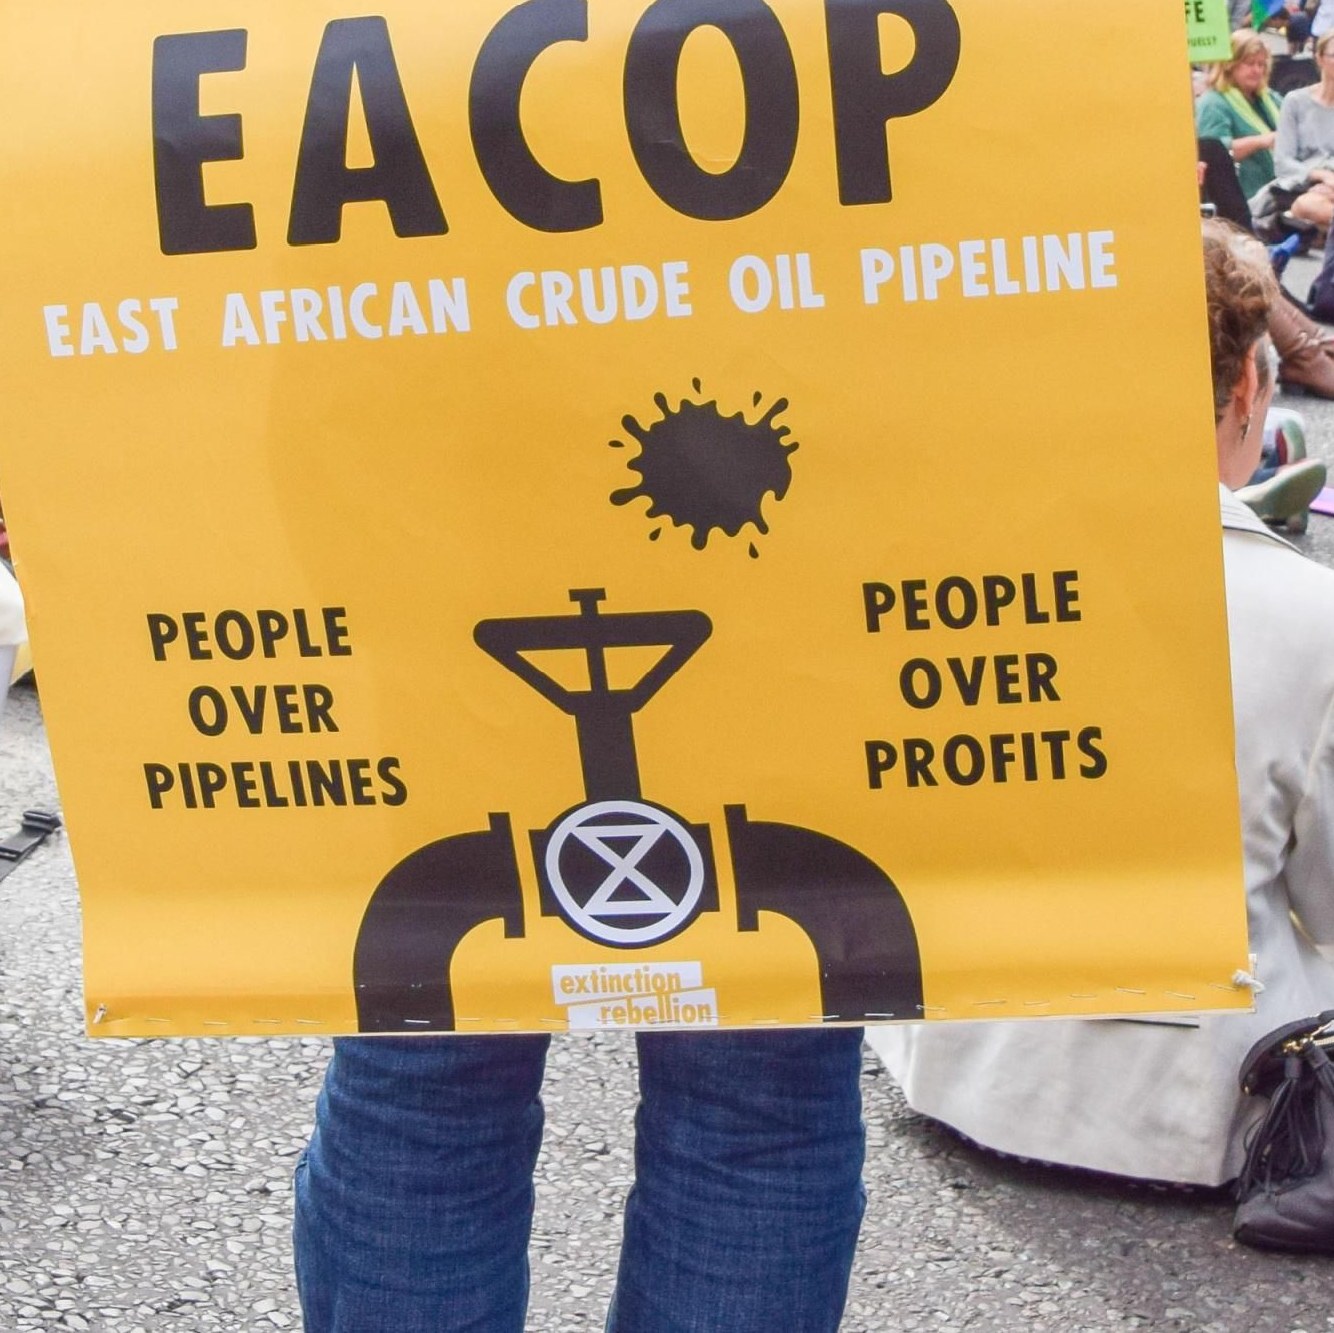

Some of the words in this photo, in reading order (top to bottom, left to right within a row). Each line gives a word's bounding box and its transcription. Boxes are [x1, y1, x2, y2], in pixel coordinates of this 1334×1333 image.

[43, 298, 179, 357] EAST
[222, 278, 471, 347] AFRICAN
[507, 262, 692, 328] CRUDE
[730, 254, 825, 313] OIL
[861, 231, 1118, 304] PIPELINE
[863, 571, 1082, 633] PEOPLE
[147, 607, 352, 662] PEOPLE
[900, 653, 1061, 709] OVER
[189, 685, 339, 736] OVER
[144, 757, 408, 809] PIPELINES
[865, 727, 1108, 789] PROFITS
[559, 966, 682, 995] extinction
[600, 992, 712, 1025] rebellion
